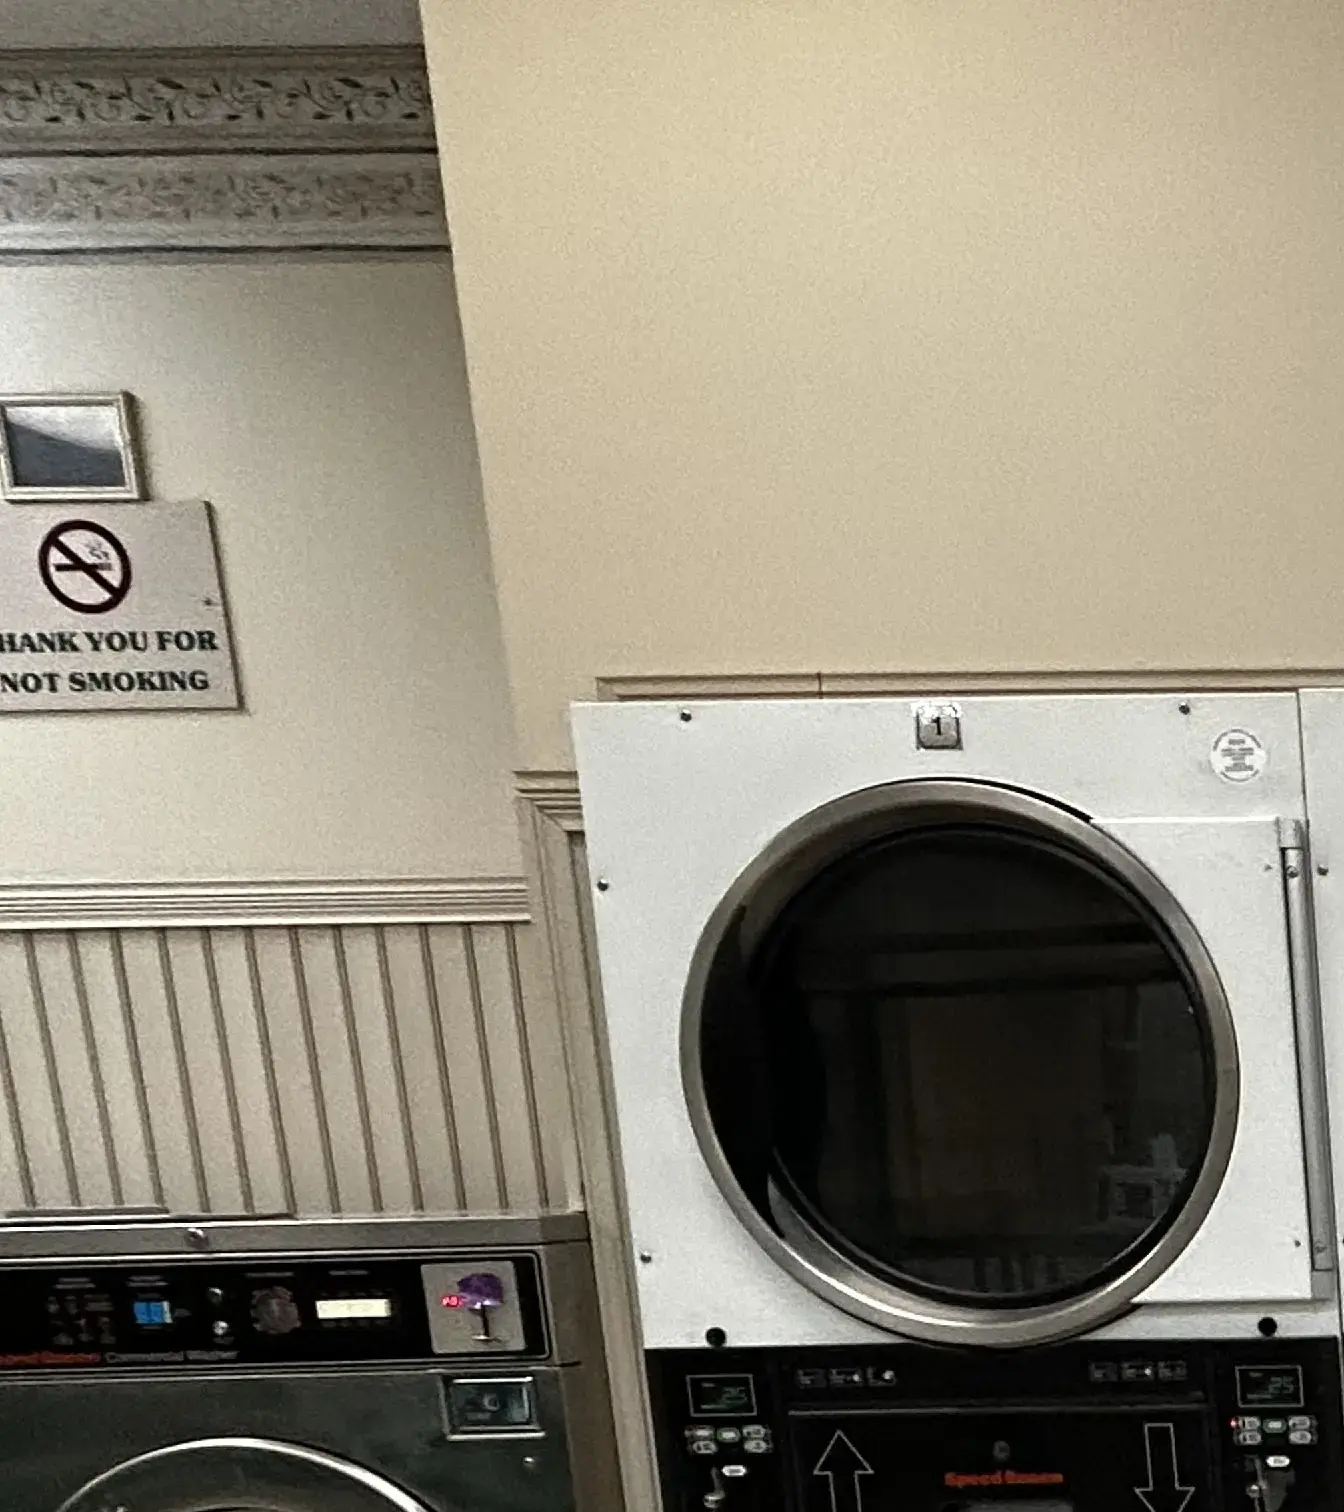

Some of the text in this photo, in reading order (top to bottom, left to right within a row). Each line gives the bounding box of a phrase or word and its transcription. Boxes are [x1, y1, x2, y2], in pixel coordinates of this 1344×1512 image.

[0, 630, 219, 653] HANK YOU FOR
[0, 670, 210, 693] NOT SMOKING
[930, 716, 942, 736] 1
[945, 1470, 1003, 1488] Speed
